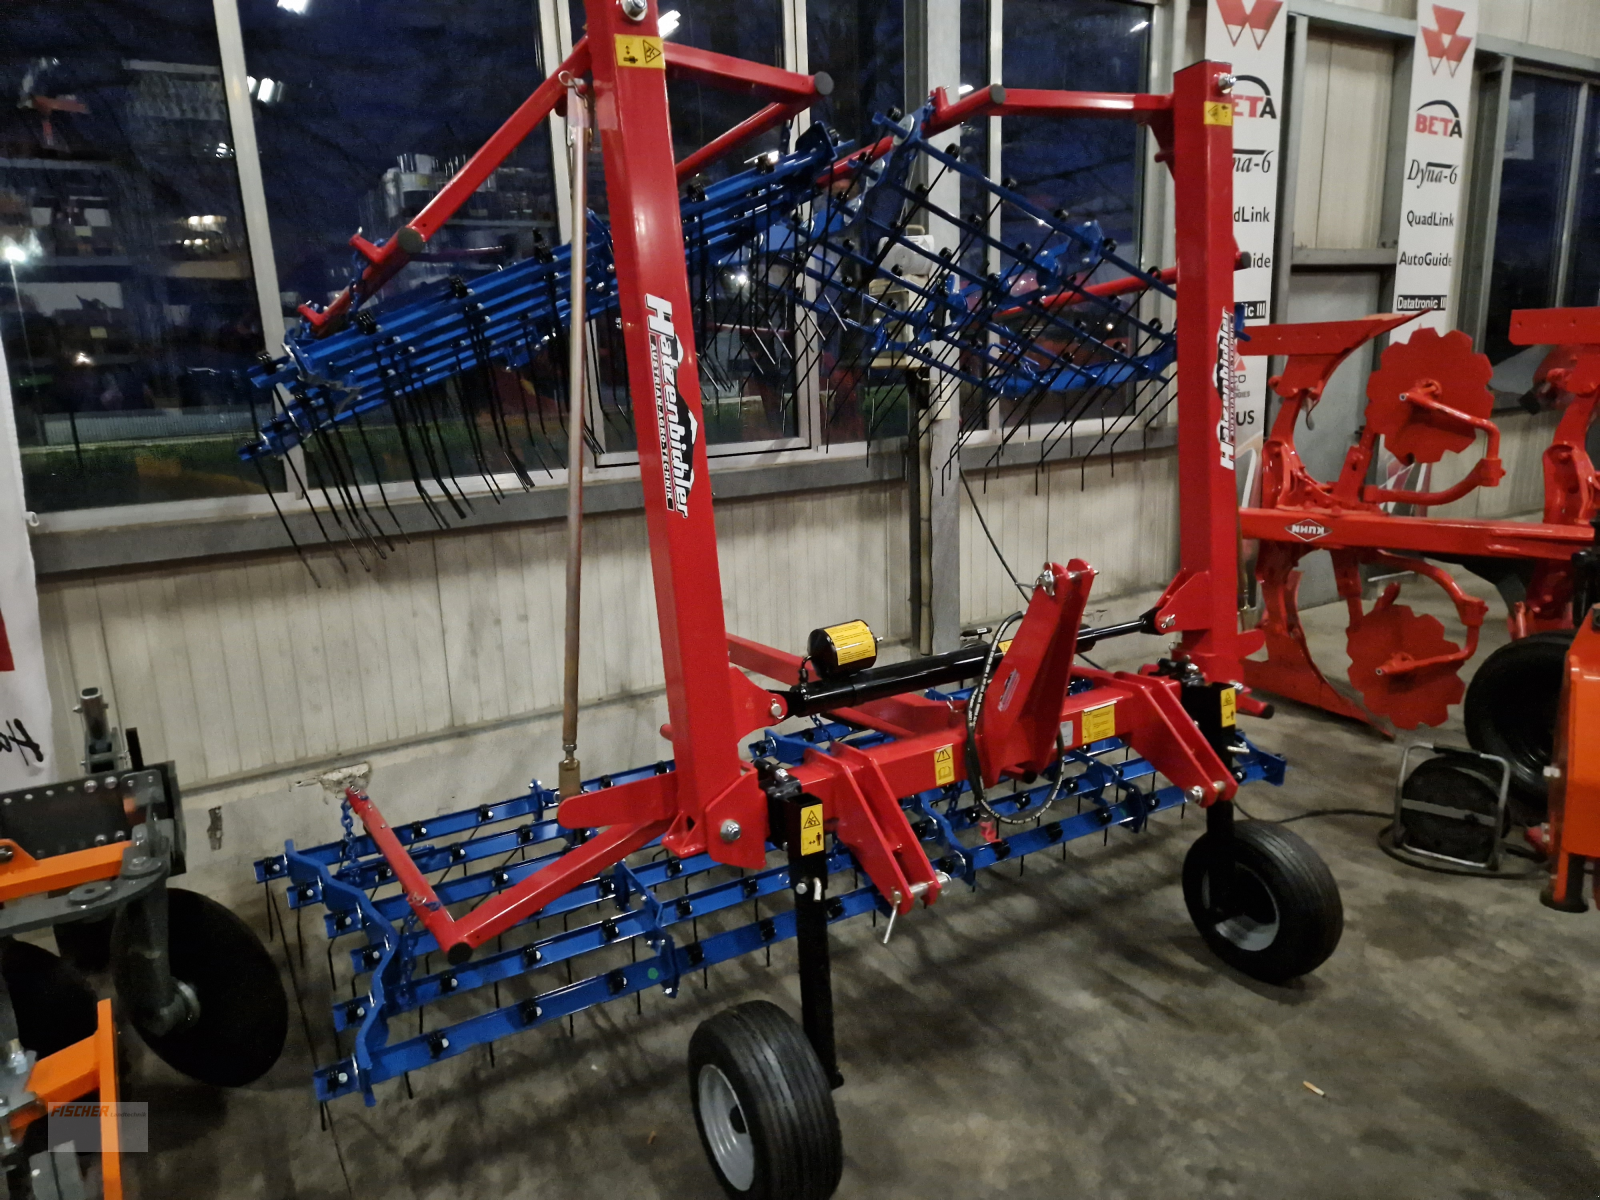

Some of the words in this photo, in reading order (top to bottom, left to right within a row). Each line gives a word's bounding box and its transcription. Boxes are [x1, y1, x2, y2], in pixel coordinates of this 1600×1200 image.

[1231, 94, 1277, 119] ETA
[1414, 112, 1463, 139] BETA
[1232, 149, 1274, 173] na-6
[1406, 158, 1459, 189] Dyna-6
[1233, 206, 1270, 223] dLink
[1406, 210, 1454, 228] QuadLink
[1397, 296, 1438, 309] Datatronic
[1219, 306, 1235, 471] Hatzenbichler
[645, 293, 688, 517] Hatzenbichler
[1291, 524, 1325, 535] KUHN
